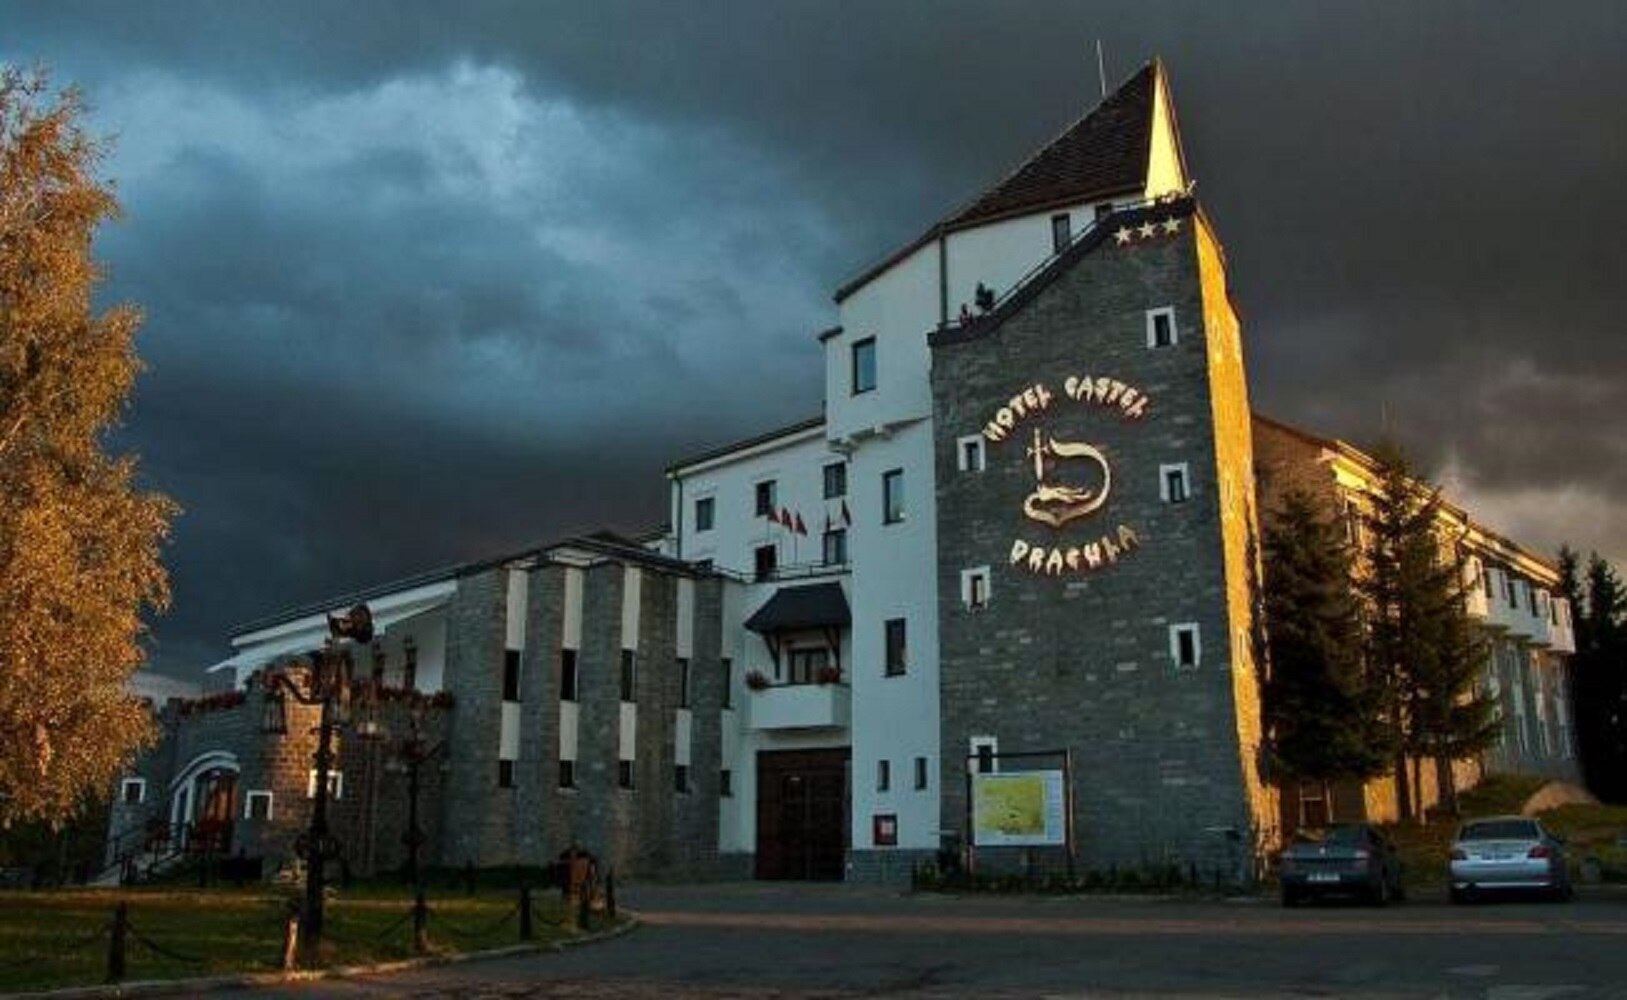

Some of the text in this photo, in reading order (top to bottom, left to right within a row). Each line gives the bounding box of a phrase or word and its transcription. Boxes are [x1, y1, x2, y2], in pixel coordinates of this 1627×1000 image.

[982, 375, 1148, 441] HOTEL CASTEL
[1010, 524, 1140, 575] DRACULA
